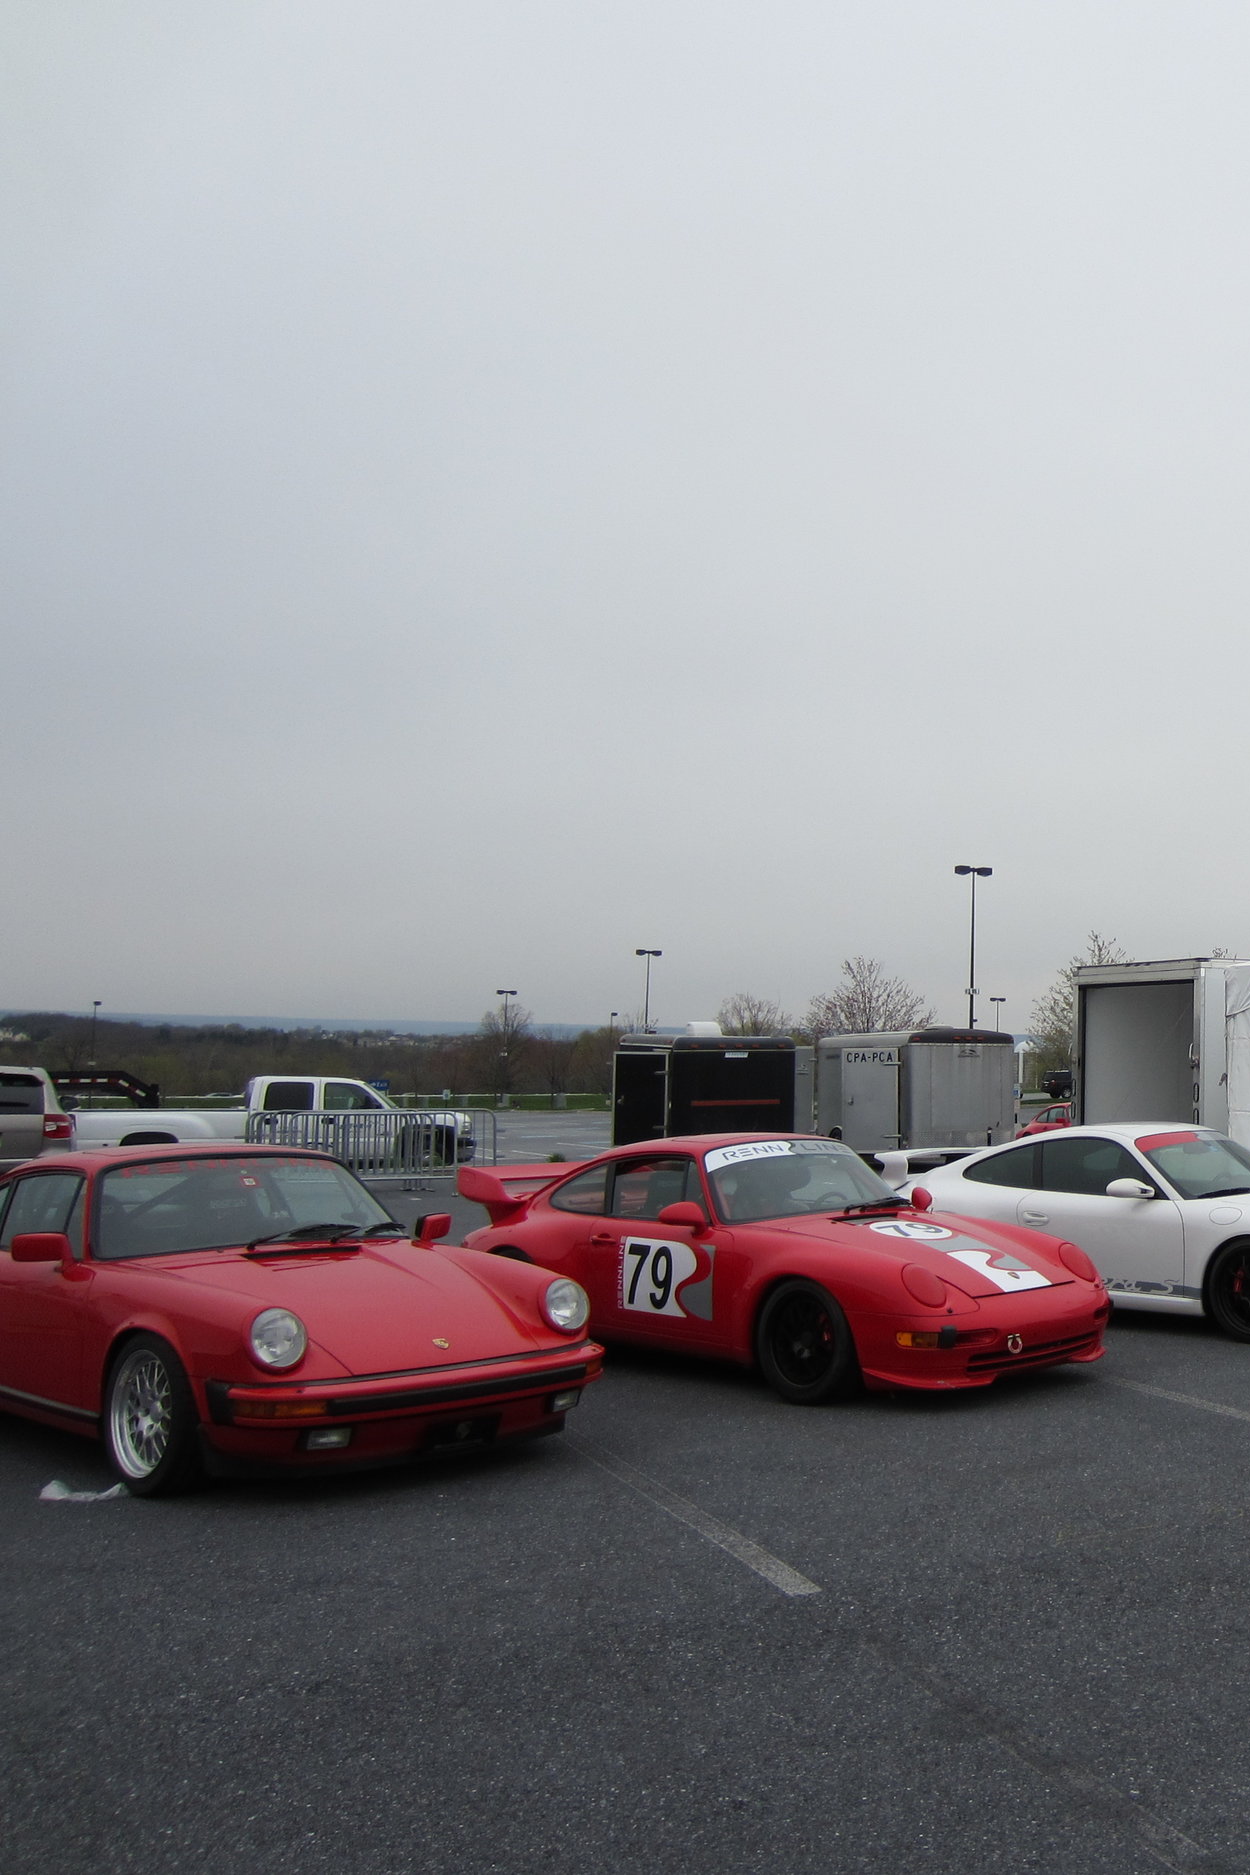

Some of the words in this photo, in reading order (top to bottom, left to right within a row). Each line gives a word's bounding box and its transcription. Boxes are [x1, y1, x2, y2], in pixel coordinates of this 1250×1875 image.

[846, 1053, 893, 1063] CPA-PCA
[722, 1144, 784, 1161] RENN
[875, 1222, 944, 1237] 79
[617, 1236, 628, 1309] RENNLINE
[628, 1243, 673, 1310] 79
